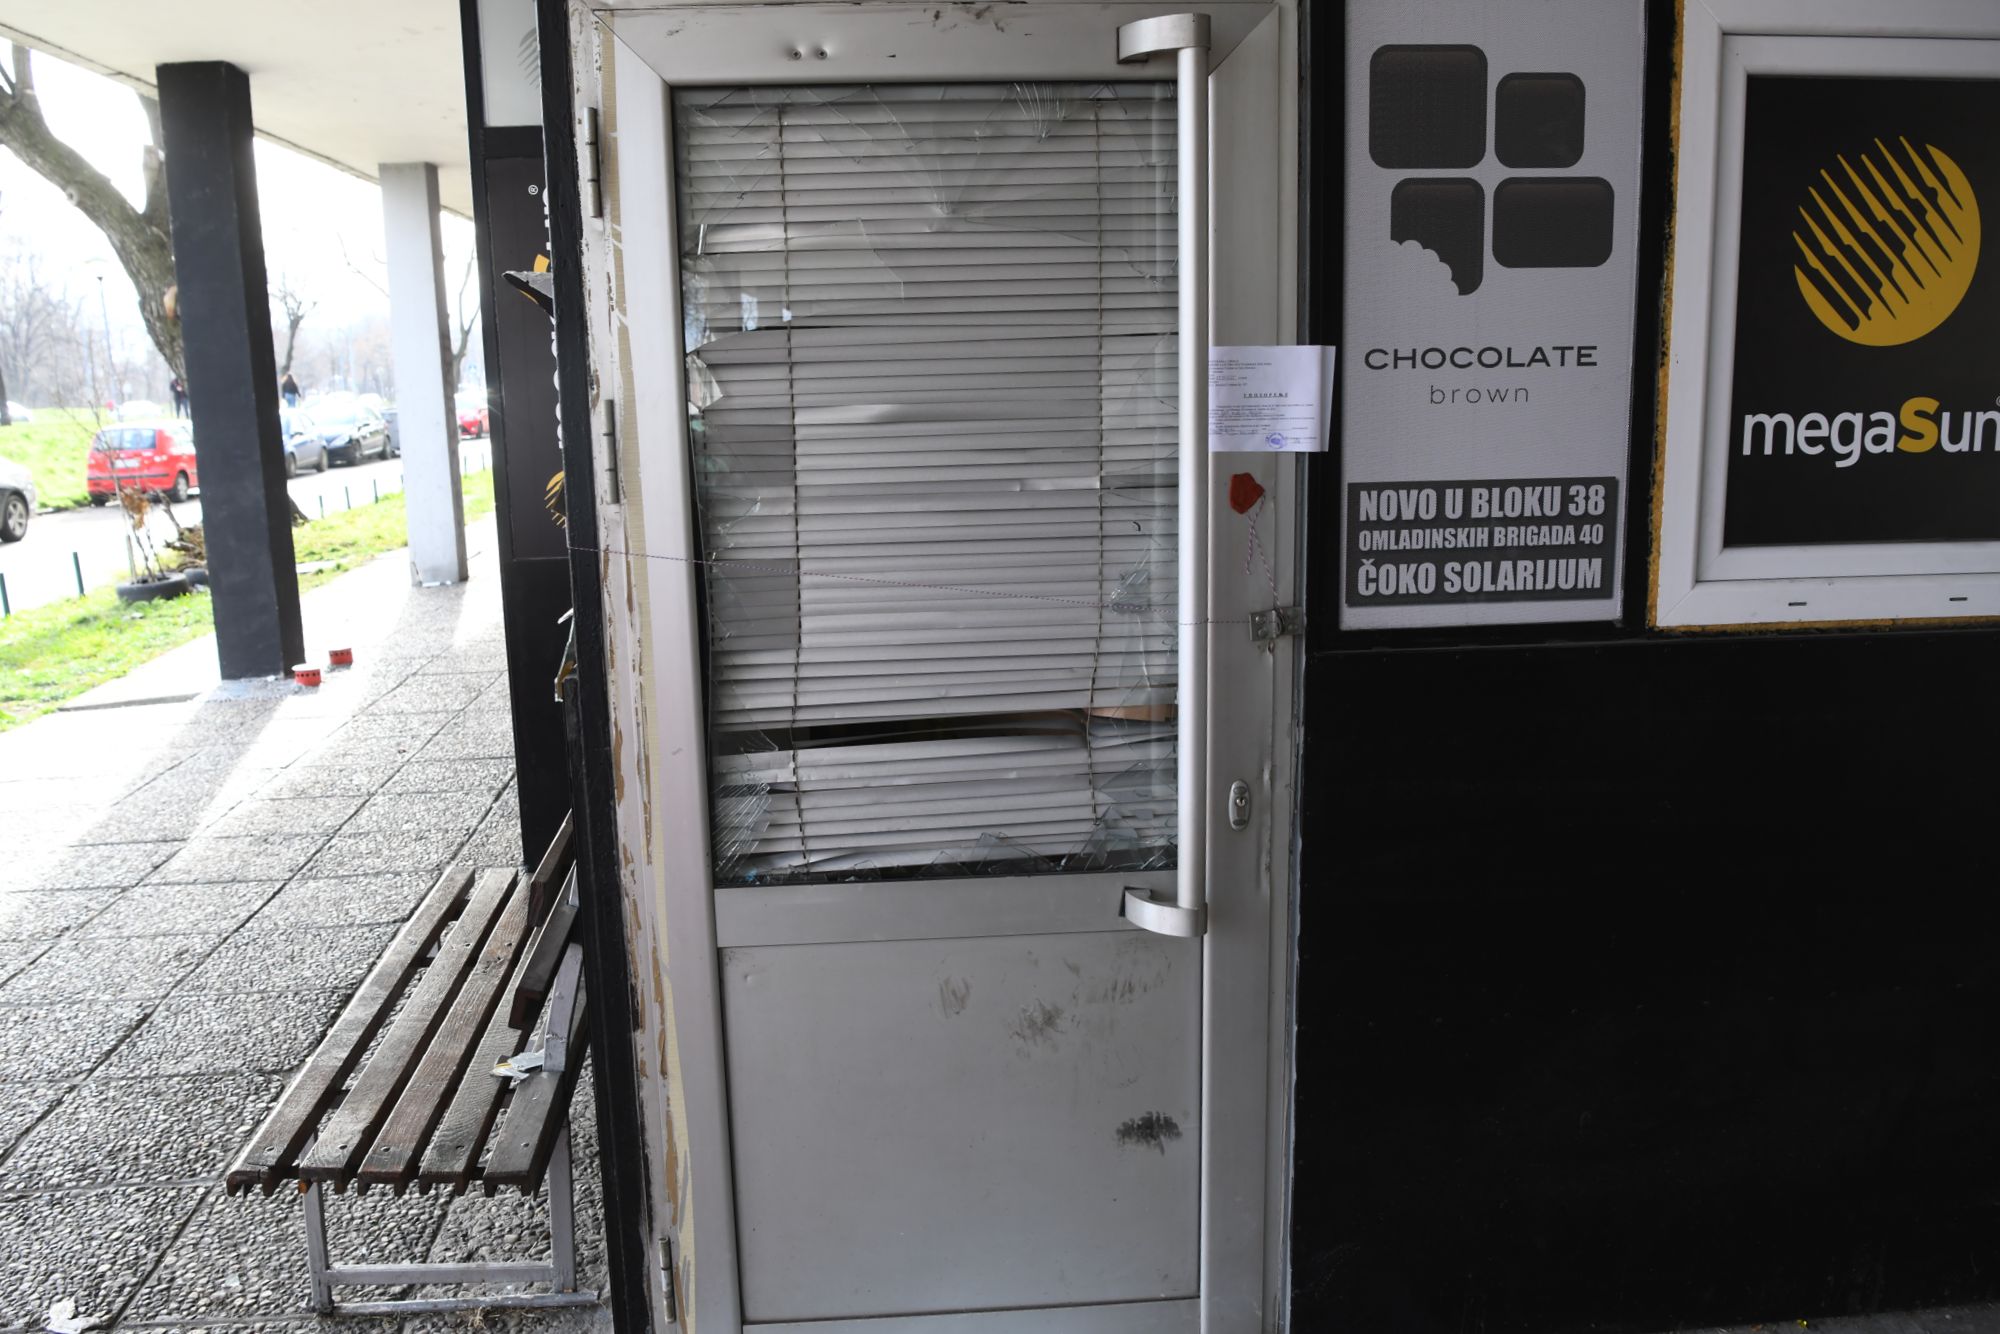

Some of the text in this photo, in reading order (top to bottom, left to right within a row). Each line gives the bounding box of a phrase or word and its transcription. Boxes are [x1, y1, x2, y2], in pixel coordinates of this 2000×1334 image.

[1364, 345, 1598, 370] CHOCOLATE
[1430, 385, 1529, 405] brown
[1742, 396, 2000, 468] megaSun
[1359, 484, 1605, 522] NOVO U BLOKU 38
[1358, 524, 1604, 552] OMLADINSKIH BRIGADA 40
[1357, 558, 1602, 596] ČOKO SOLARIJUM
